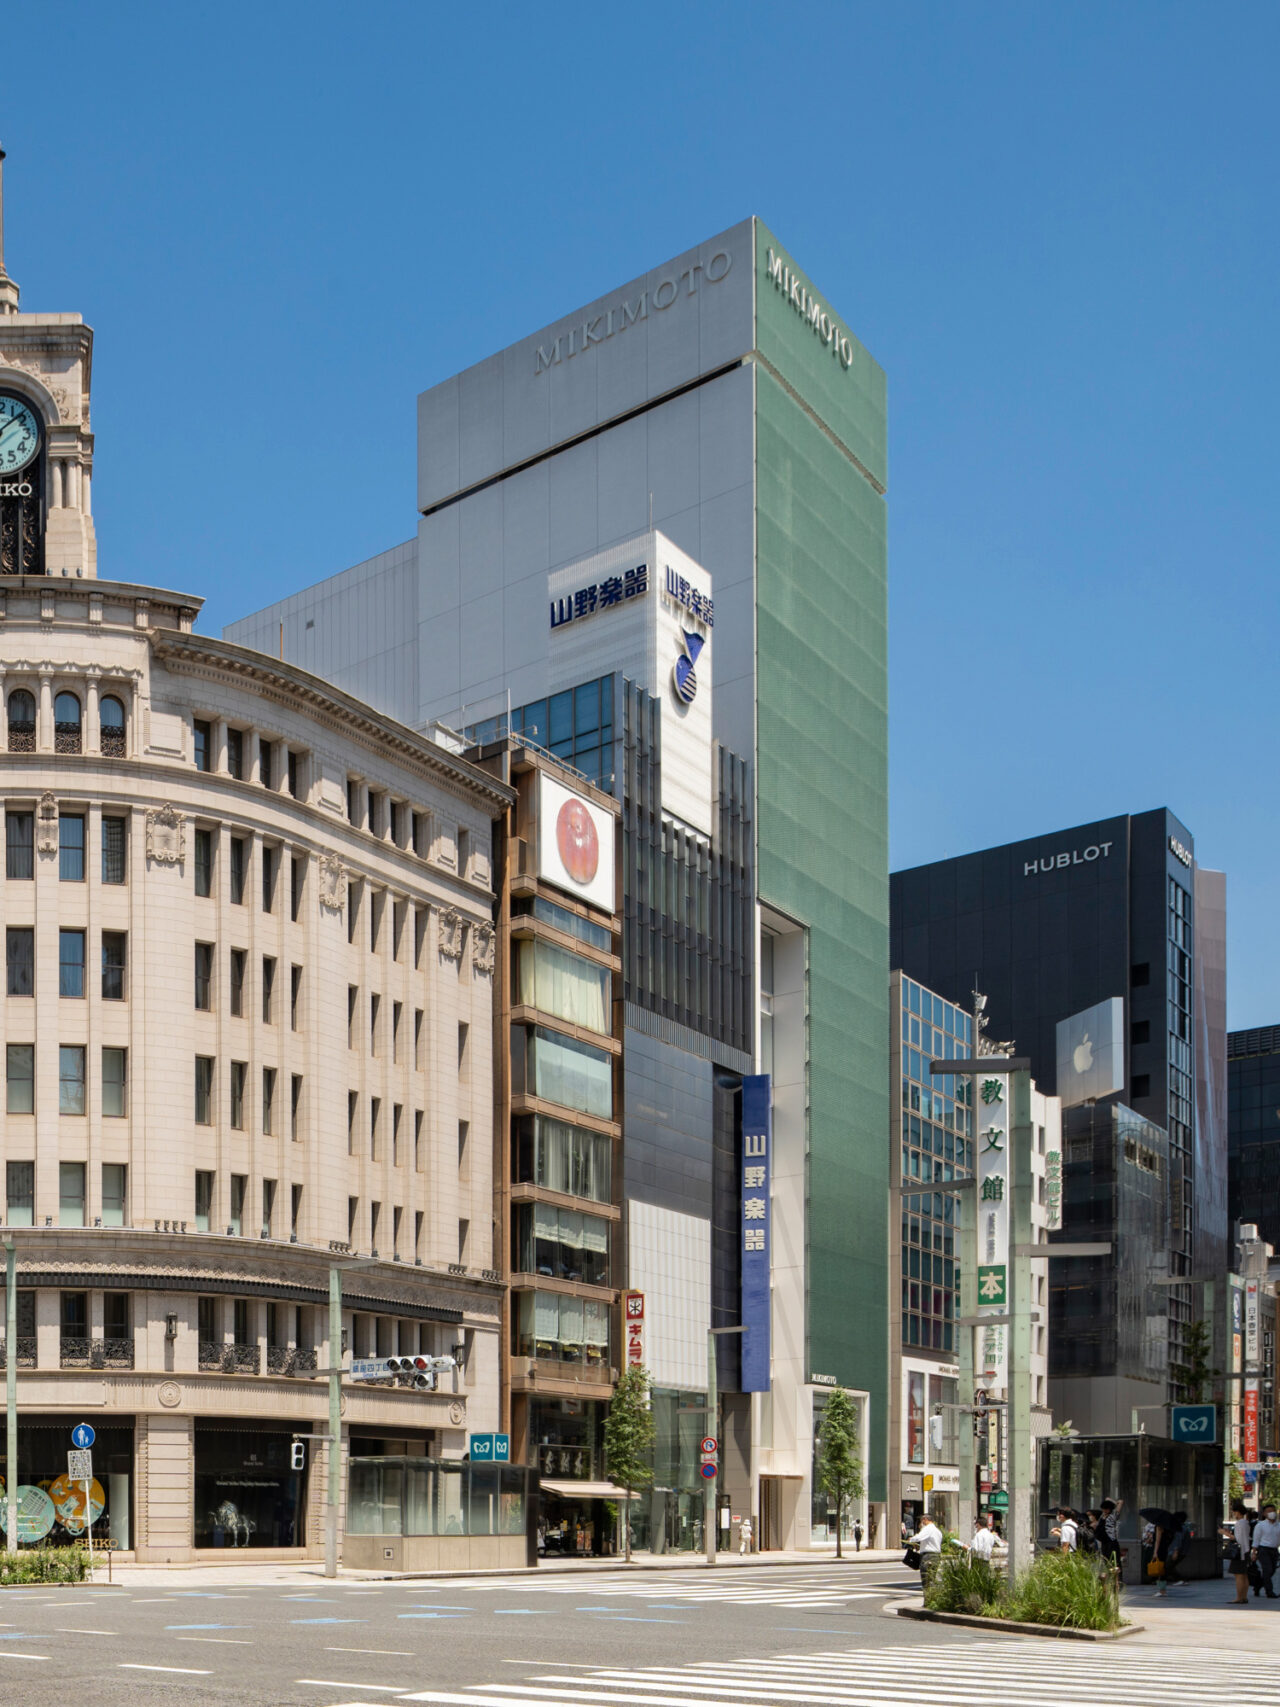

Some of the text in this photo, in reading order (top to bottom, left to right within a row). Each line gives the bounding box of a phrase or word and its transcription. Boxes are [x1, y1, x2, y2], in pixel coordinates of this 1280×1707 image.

[534, 251, 733, 376] MIKIMOTO
[766, 247, 853, 370] MIKIMOTO
[10, 406, 14, 417] 1
[19, 414, 27, 426] 2
[17, 441, 27, 454] 4
[22, 428, 31, 440] 3
[7, 451, 16, 463] 5
[551, 564, 648, 629] 山野楽器
[665, 565, 714, 627] 山野楽器
[1023, 841, 1113, 877] HUBLOT
[1170, 835, 1193, 867] HUBLOT
[981, 1078, 1004, 1202] 教文館
[745, 1135, 766, 1251] 山野楽器
[1048, 1150, 1061, 1226] 教文館ビル
[980, 1271, 1003, 1300] 本
[74, 1538, 119, 1548] SEIKO
